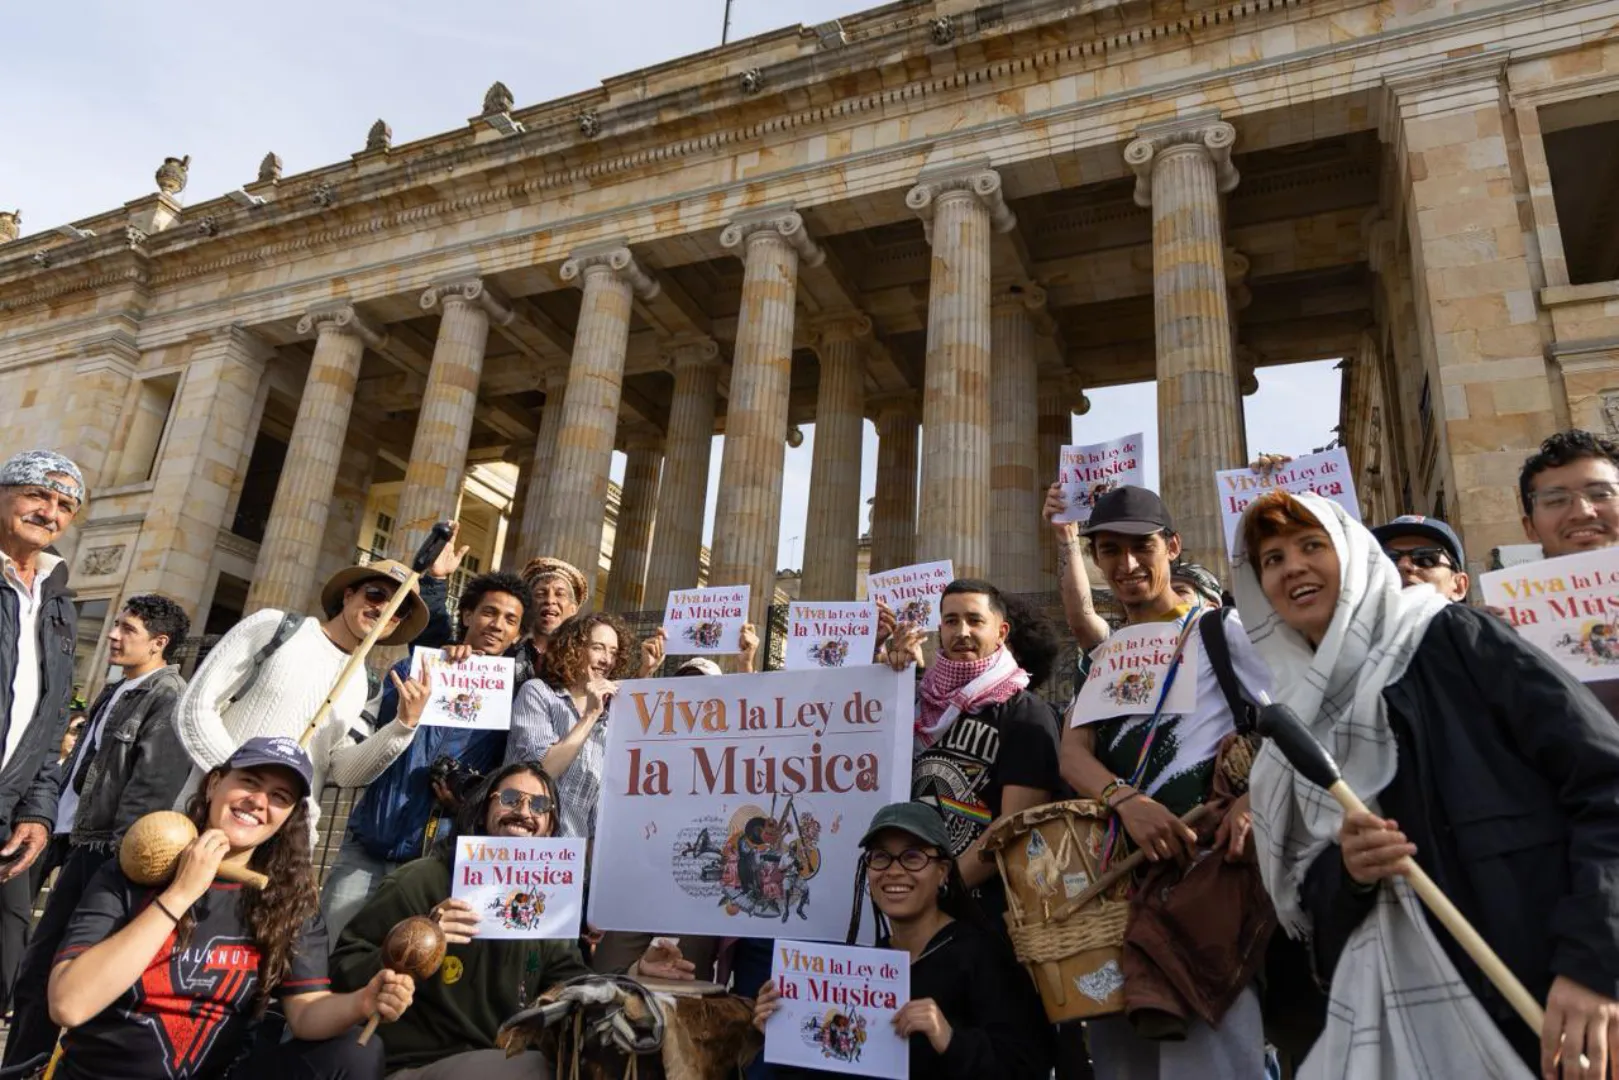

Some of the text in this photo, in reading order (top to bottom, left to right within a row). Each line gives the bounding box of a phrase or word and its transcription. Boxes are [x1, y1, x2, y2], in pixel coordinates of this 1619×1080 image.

[1063, 443, 1136, 465] iva la Ley de
[1060, 458, 1137, 484] a Música
[1223, 461, 1339, 492] Viva la Ley de
[1228, 495, 1249, 514] la
[872, 568, 947, 588] Viva la Ley de
[1501, 571, 1619, 599] Viva la Le
[674, 593, 744, 605] Viva la Ley de
[670, 604, 742, 620] la Música
[793, 606, 872, 620] Viva la Ley de
[1508, 594, 1619, 627] la Mús
[793, 622, 870, 637] la Música
[1126, 639, 1137, 650] la
[1140, 637, 1163, 648] Ley
[1169, 636, 1180, 646] d
[469, 662, 489, 675] Ley
[492, 664, 507, 674] de
[439, 671, 504, 690] Música
[629, 690, 883, 738] Viva la Ley de
[938, 717, 1000, 764] LOYD
[623, 748, 672, 796] la
[689, 742, 880, 796] Música
[464, 843, 576, 864] Viva la Ley de
[463, 865, 574, 886] la Música
[780, 947, 899, 980] Viva la Ley de
[779, 974, 898, 1010] la Música
